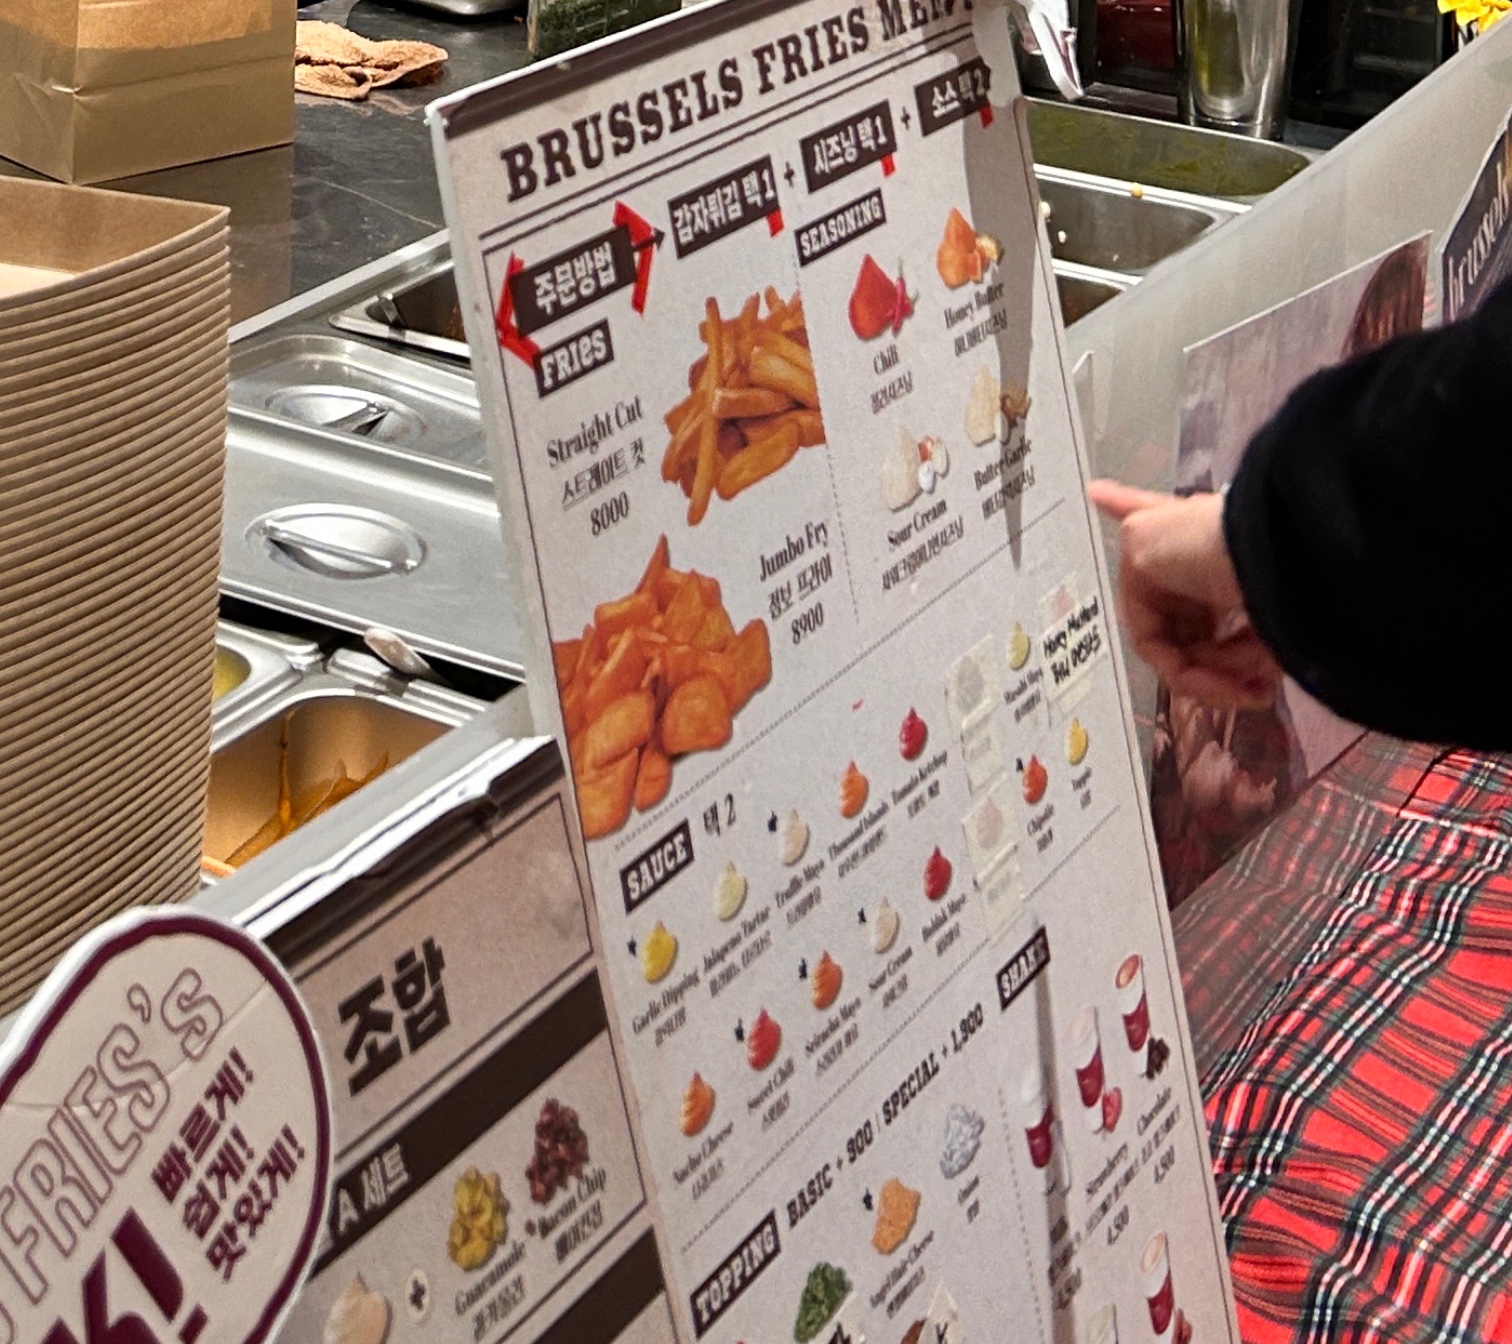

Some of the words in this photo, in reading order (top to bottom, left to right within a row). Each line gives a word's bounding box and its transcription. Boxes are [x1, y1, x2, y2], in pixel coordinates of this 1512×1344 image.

[501, 59, 742, 200] BRUSSELS
[752, 6, 869, 94] FRIES
[534, 242, 615, 312] 주문방법
[673, 180, 742, 243] 감자튀김
[813, 125, 857, 173] 시즈닝
[931, 80, 960, 118] 소스
[800, 196, 881, 256] SEASONING
[546, 412, 613, 468] Straight
[613, 395, 642, 429] Cut
[562, 452, 621, 502] 스트레이트
[589, 491, 629, 536] 8000
[759, 536, 805, 581] Jumbo
[803, 521, 828, 549] Fry
[768, 580, 793, 621] 점보
[796, 552, 832, 600] 프라이
[790, 601, 824, 645] 8900
[627, 833, 686, 899] SAUCE
[338, 937, 454, 1098] 조합
[151, 1046, 255, 1205] 빠르게!
[786, 1163, 832, 1228] BASIC
[881, 1052, 939, 1125] SPECIAL
[183, 1123, 255, 1241] 쉽게!
[205, 1123, 306, 1283] 맛있게!
[361, 1143, 410, 1212] 세트
[576, 1166, 607, 1201] Chip
[696, 1224, 774, 1322] TOPPING
